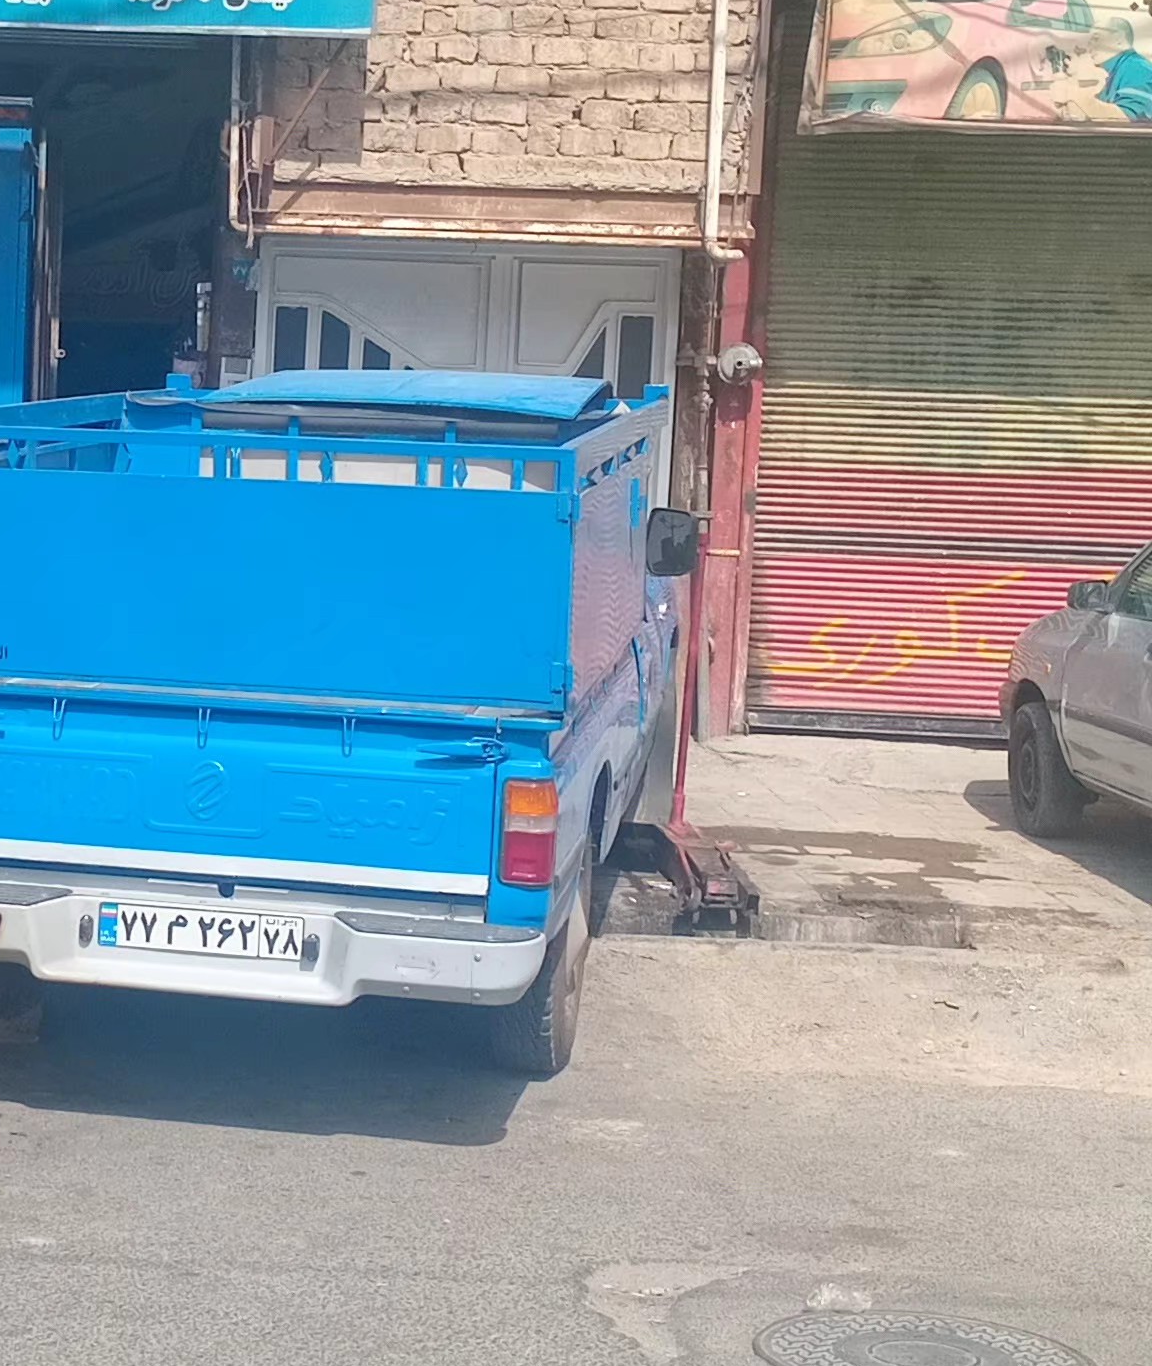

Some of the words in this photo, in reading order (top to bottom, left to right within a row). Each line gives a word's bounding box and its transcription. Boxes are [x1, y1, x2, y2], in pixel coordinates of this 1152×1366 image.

[121, 910, 158, 943] ۷۷
[167, 914, 188, 945] م
[198, 916, 256, 951] ۲۶۲
[263, 927, 298, 956] ۷۸
